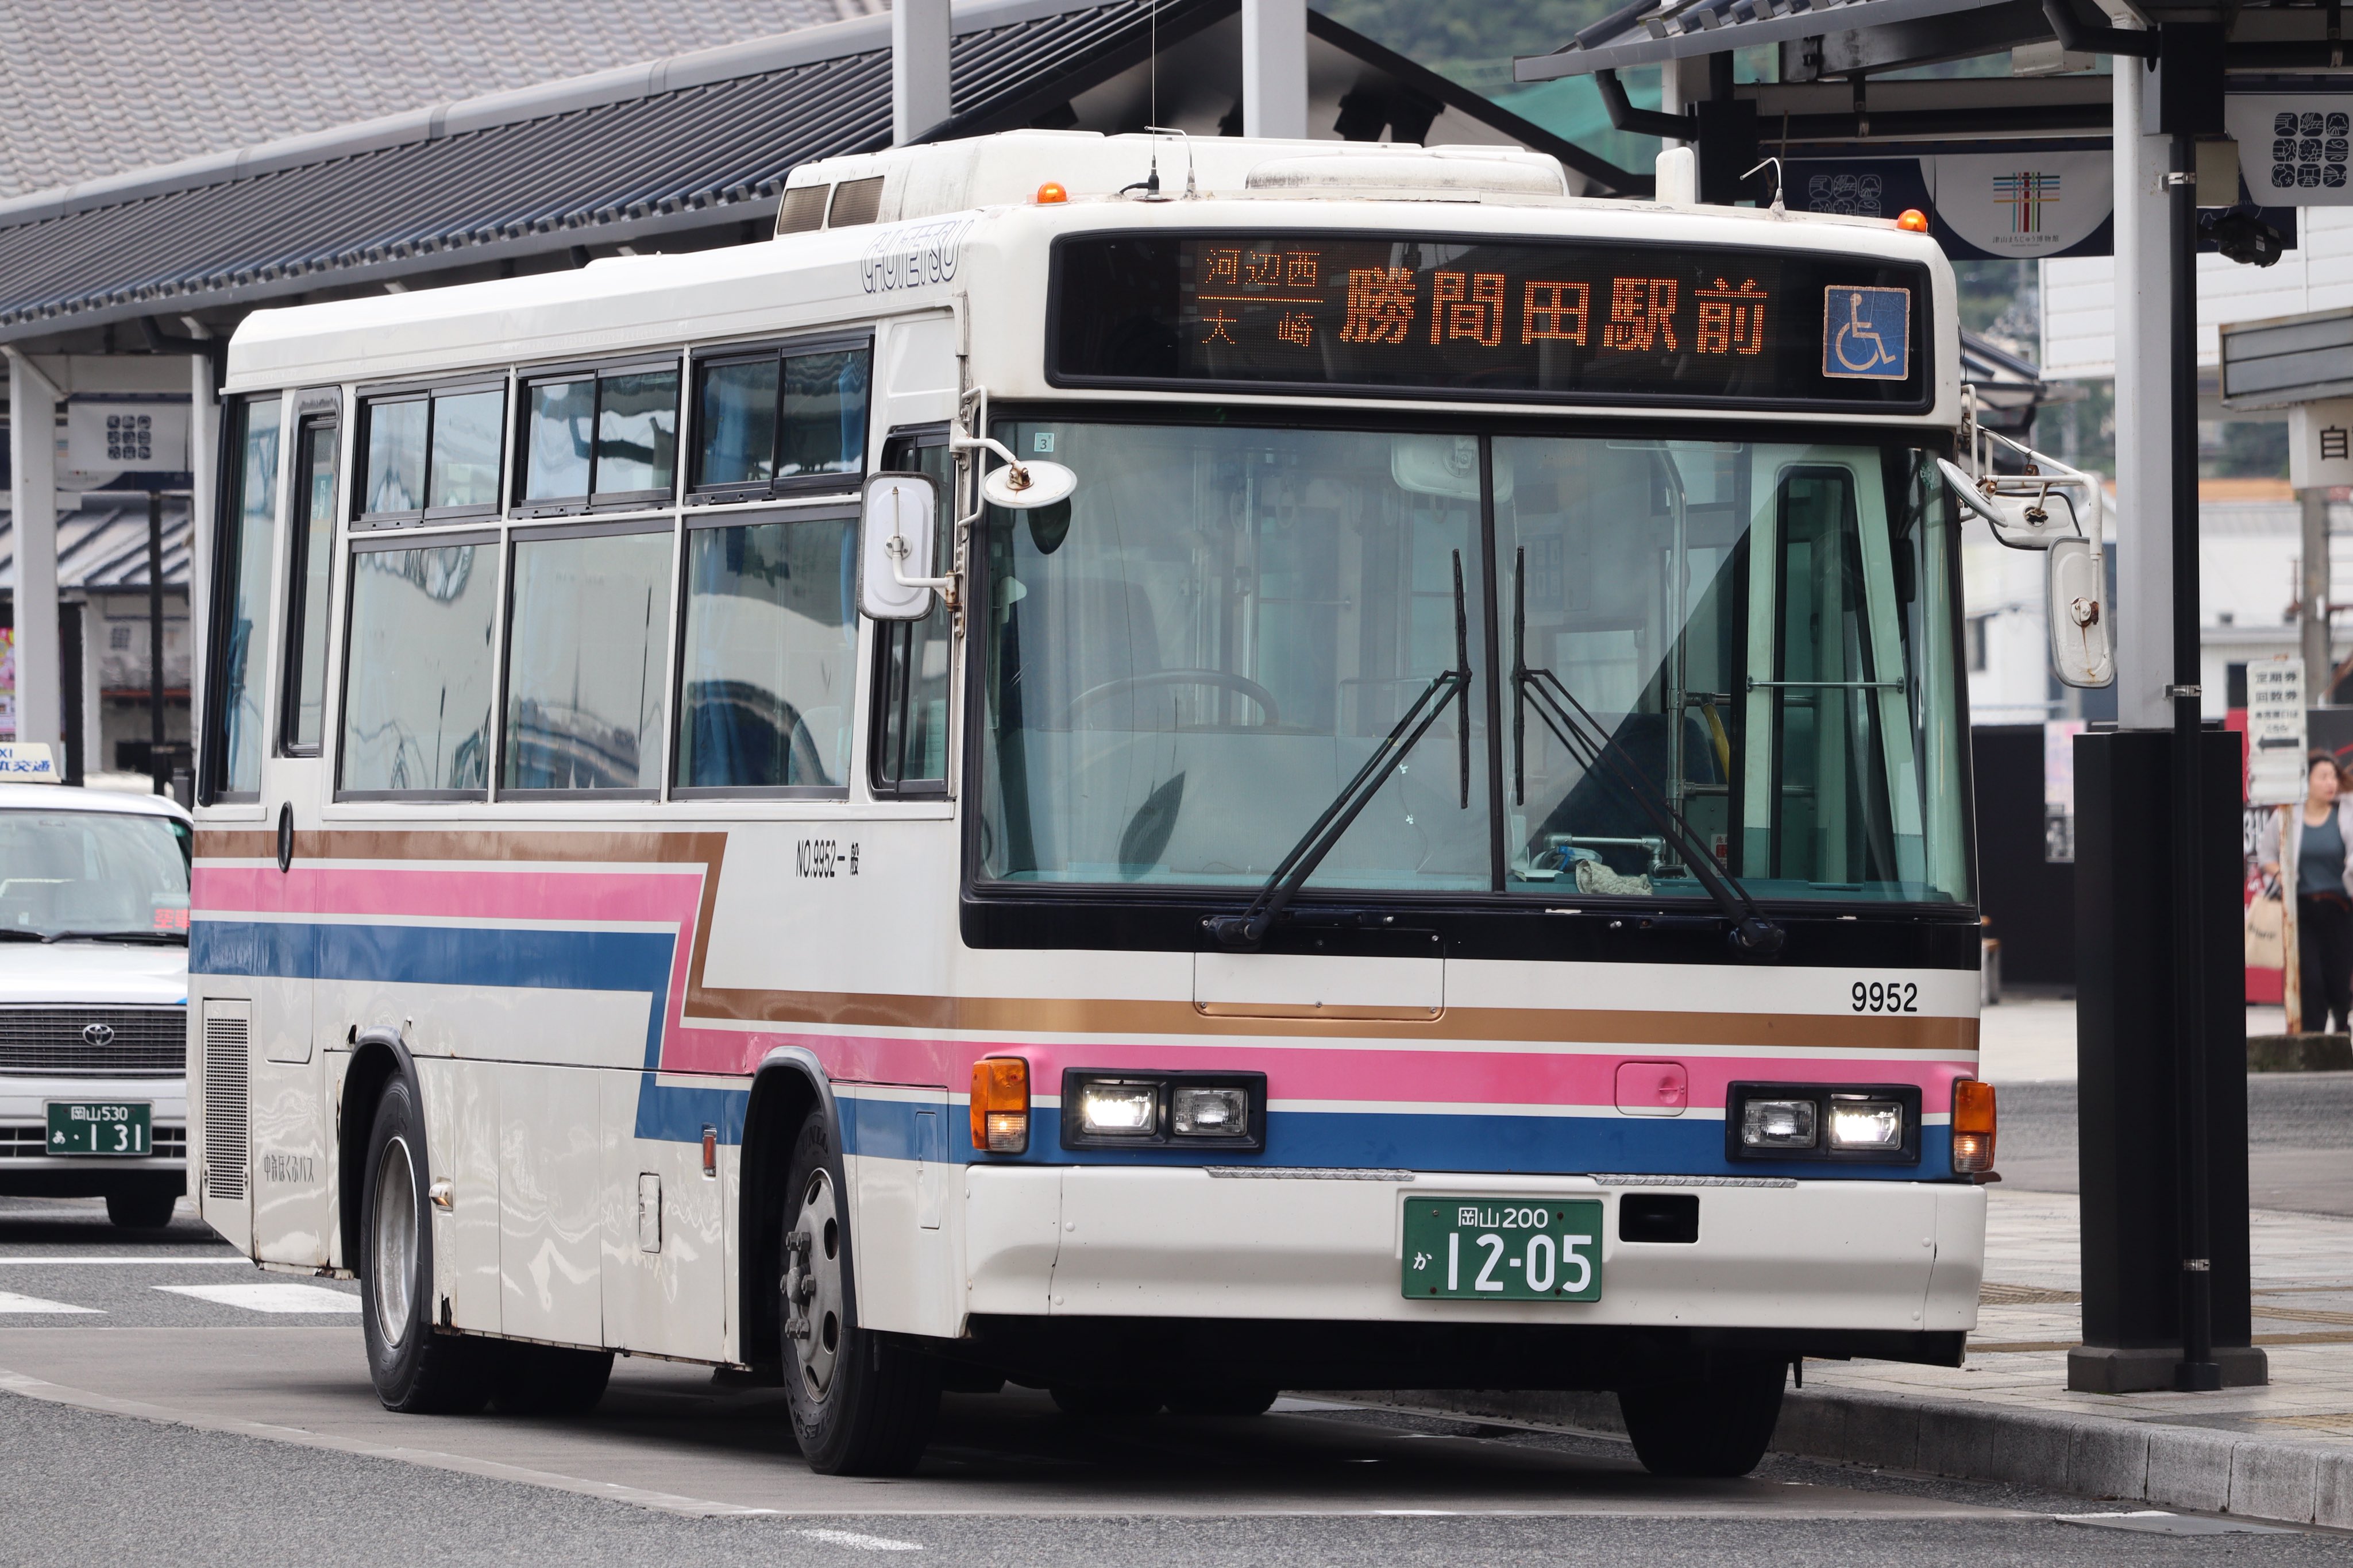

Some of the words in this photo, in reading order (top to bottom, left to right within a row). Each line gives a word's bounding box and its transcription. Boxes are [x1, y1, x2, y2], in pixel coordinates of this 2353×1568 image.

[1992, 234, 2059, 244] 津山まちじゅう博物館
[1205, 248, 1321, 287] 河辺西
[1339, 267, 1769, 356] 勝間田駅前
[1851, 981, 1918, 1012] 9952
[1448, 1232, 1592, 1293] 12-05
